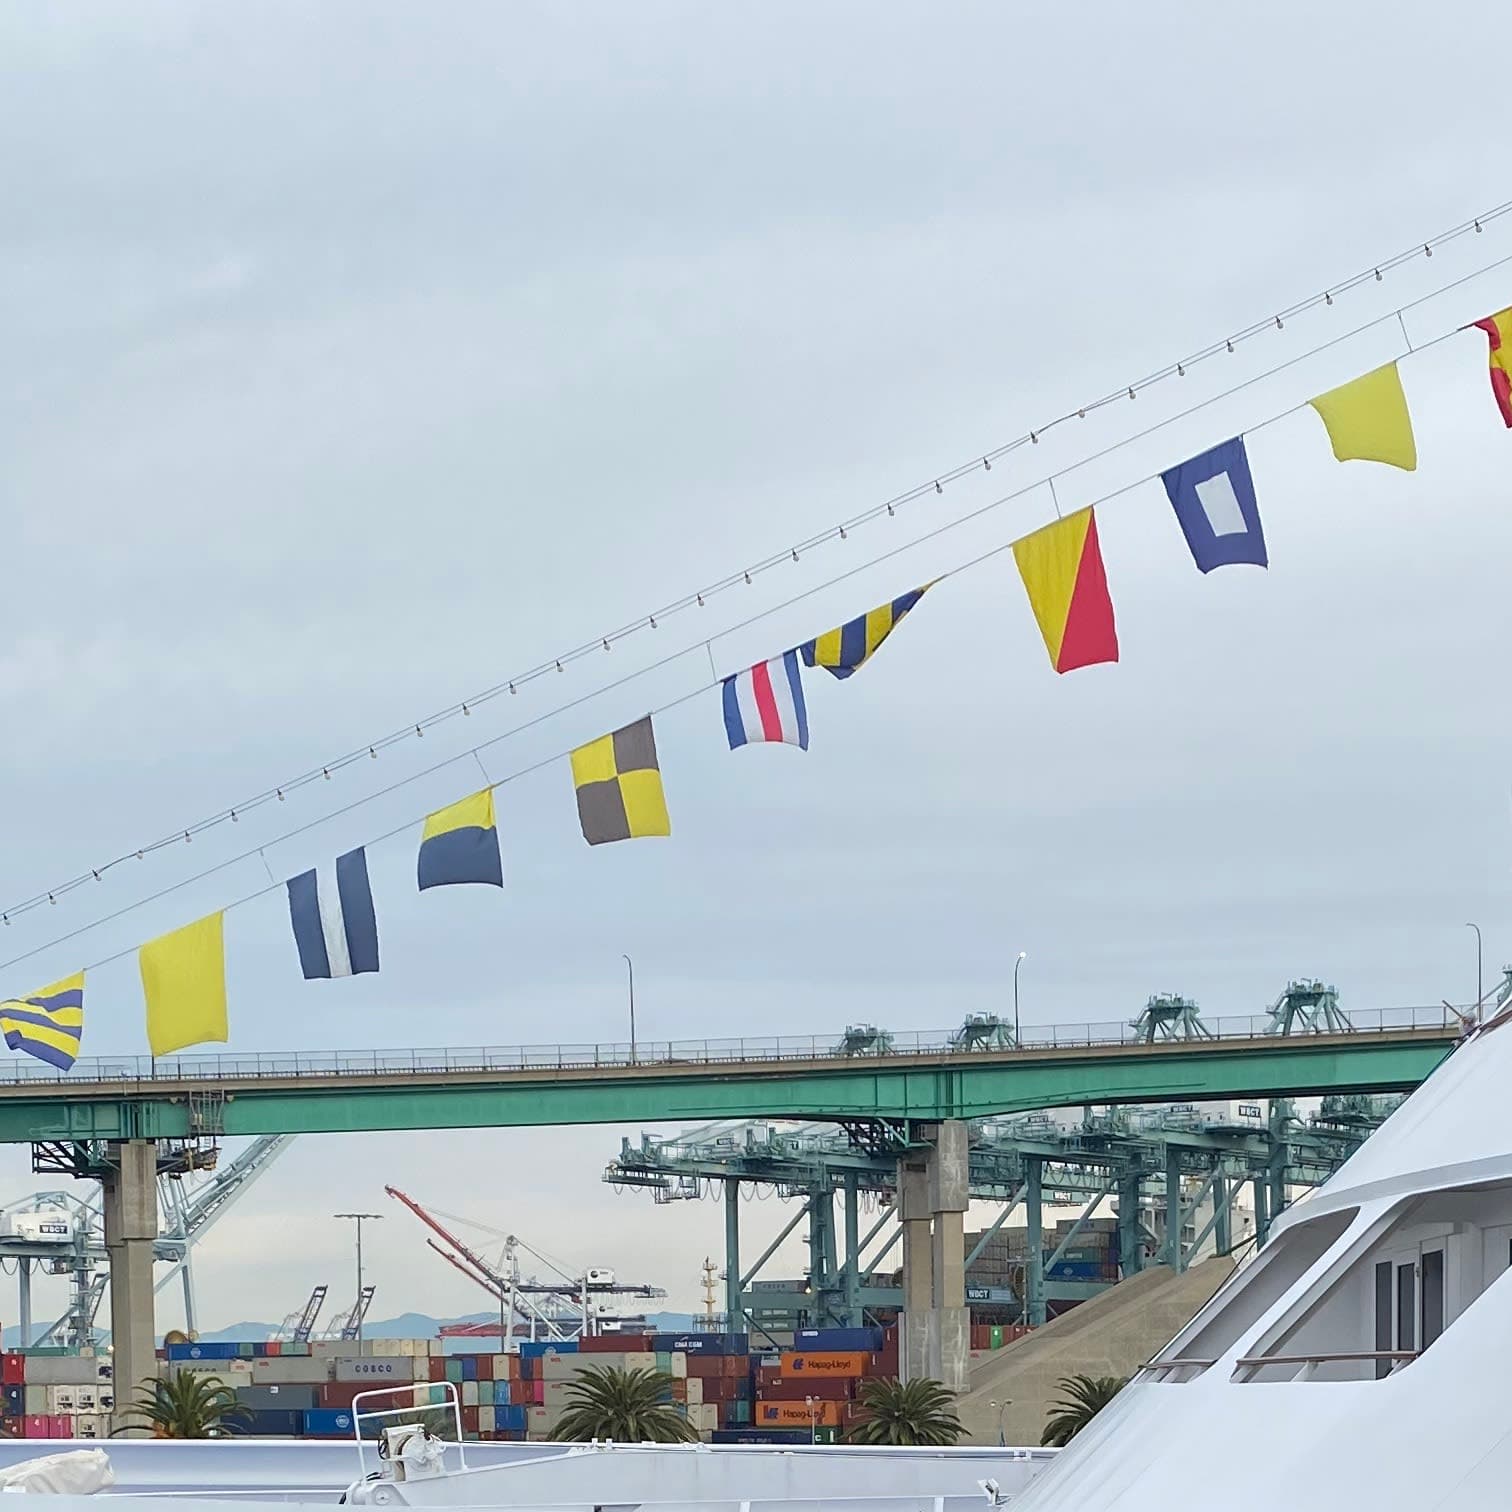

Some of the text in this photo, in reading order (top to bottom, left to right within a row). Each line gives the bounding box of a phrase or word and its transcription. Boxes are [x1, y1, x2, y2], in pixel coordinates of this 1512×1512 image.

[1240, 1106, 1260, 1117] WBCT
[41, 1225, 66, 1233] WBCT
[968, 1289, 989, 1298] WBCT
[355, 1365, 392, 1373] COSCO
[808, 1360, 851, 1370] Hapag-Lloyd
